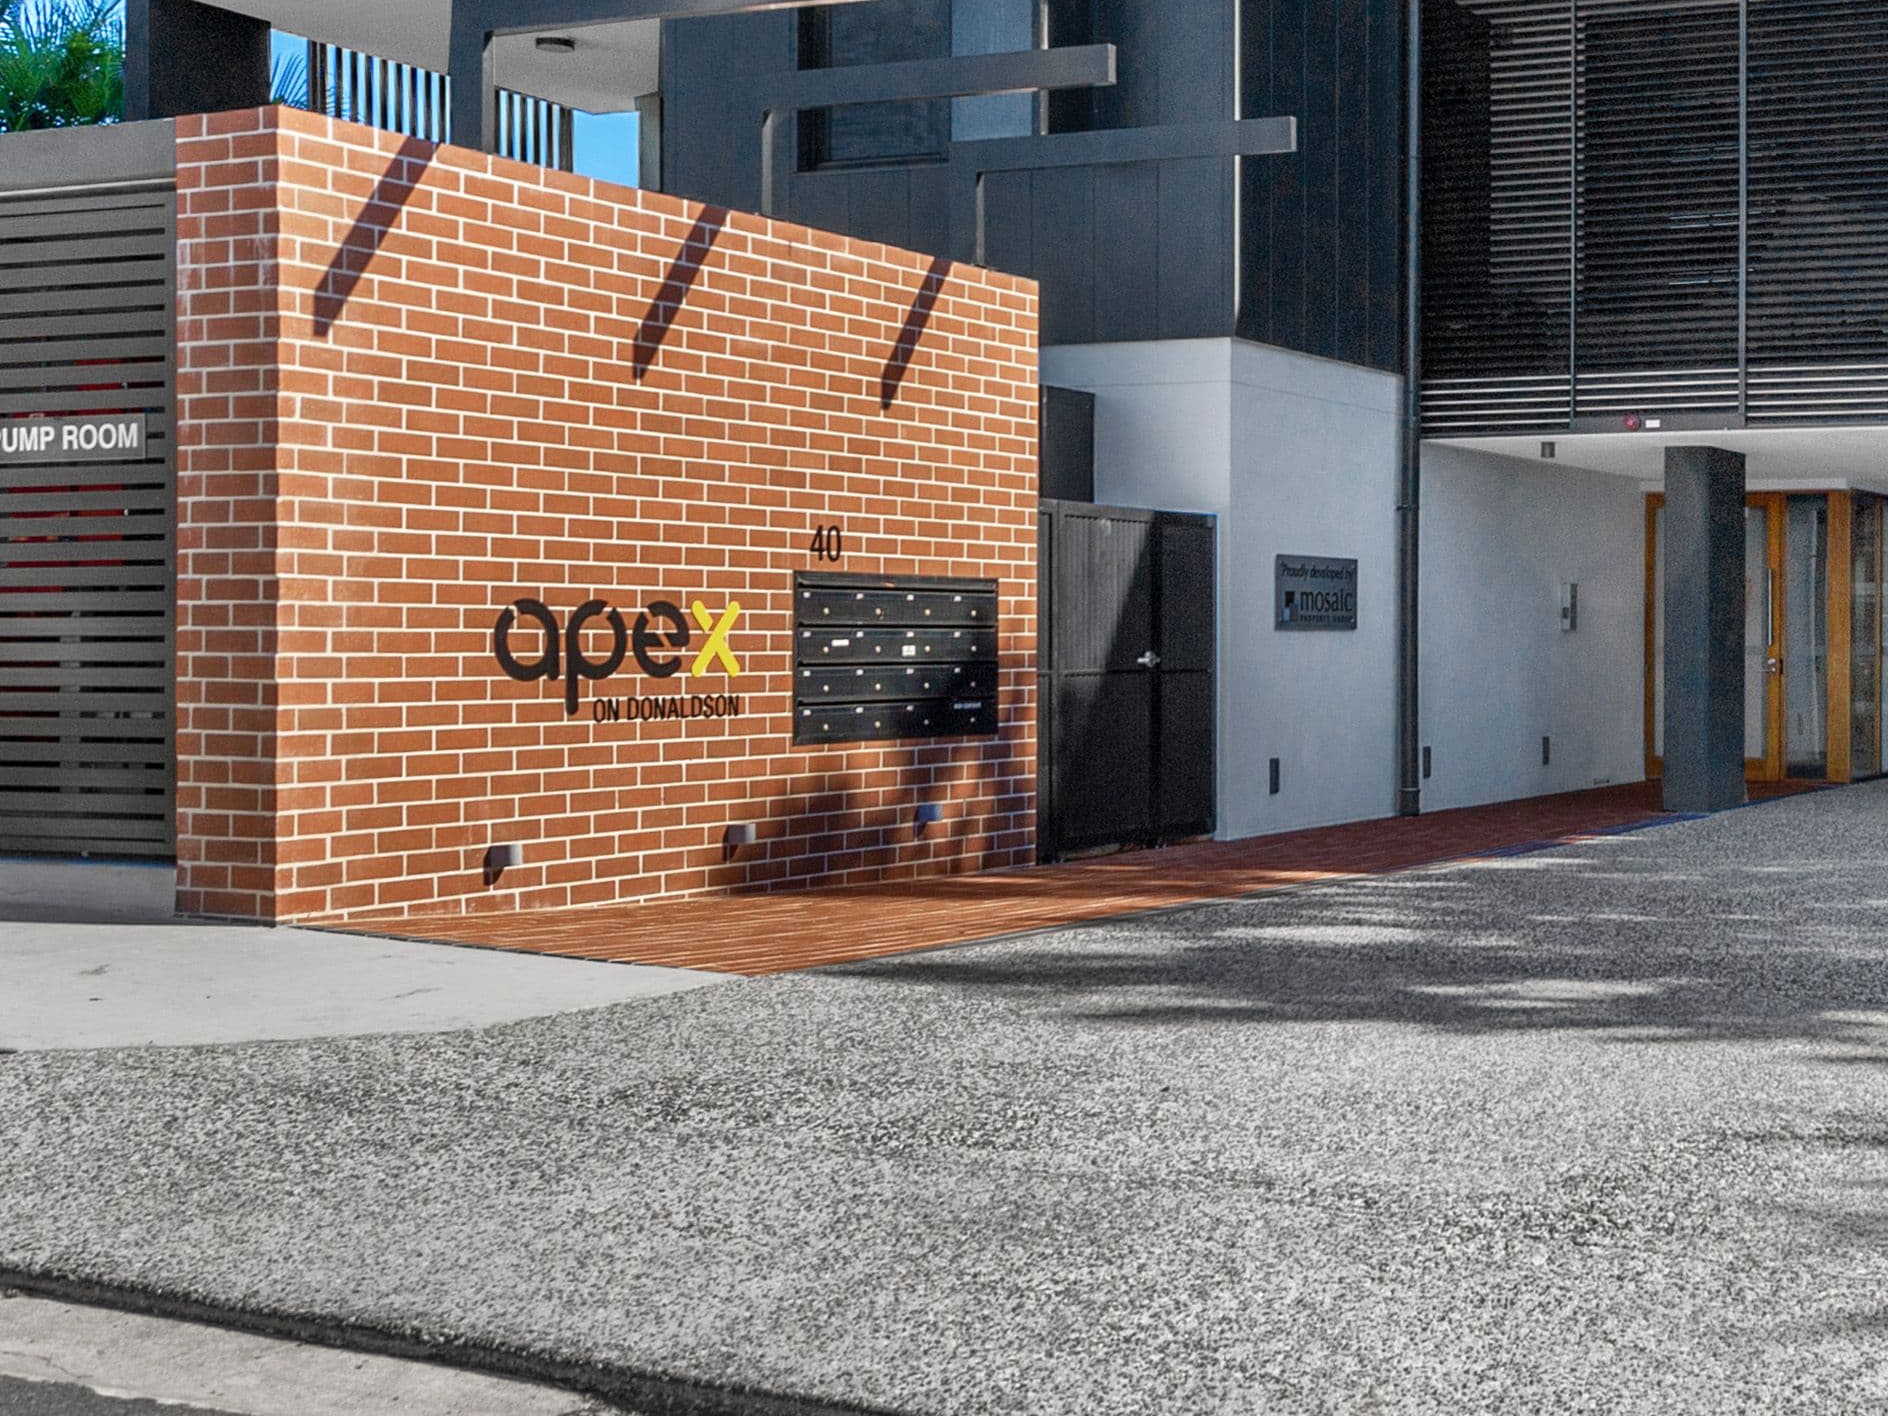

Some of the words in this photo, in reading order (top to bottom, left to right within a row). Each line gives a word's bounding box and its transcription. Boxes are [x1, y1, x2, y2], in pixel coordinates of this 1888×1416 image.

[0, 426, 55, 453] UMP
[62, 423, 138, 450] ROOM
[810, 525, 842, 563] 40
[1300, 588, 1353, 613] mosaic
[494, 598, 741, 716] apex
[593, 698, 619, 722] ON
[627, 694, 740, 720] DONALDSON
